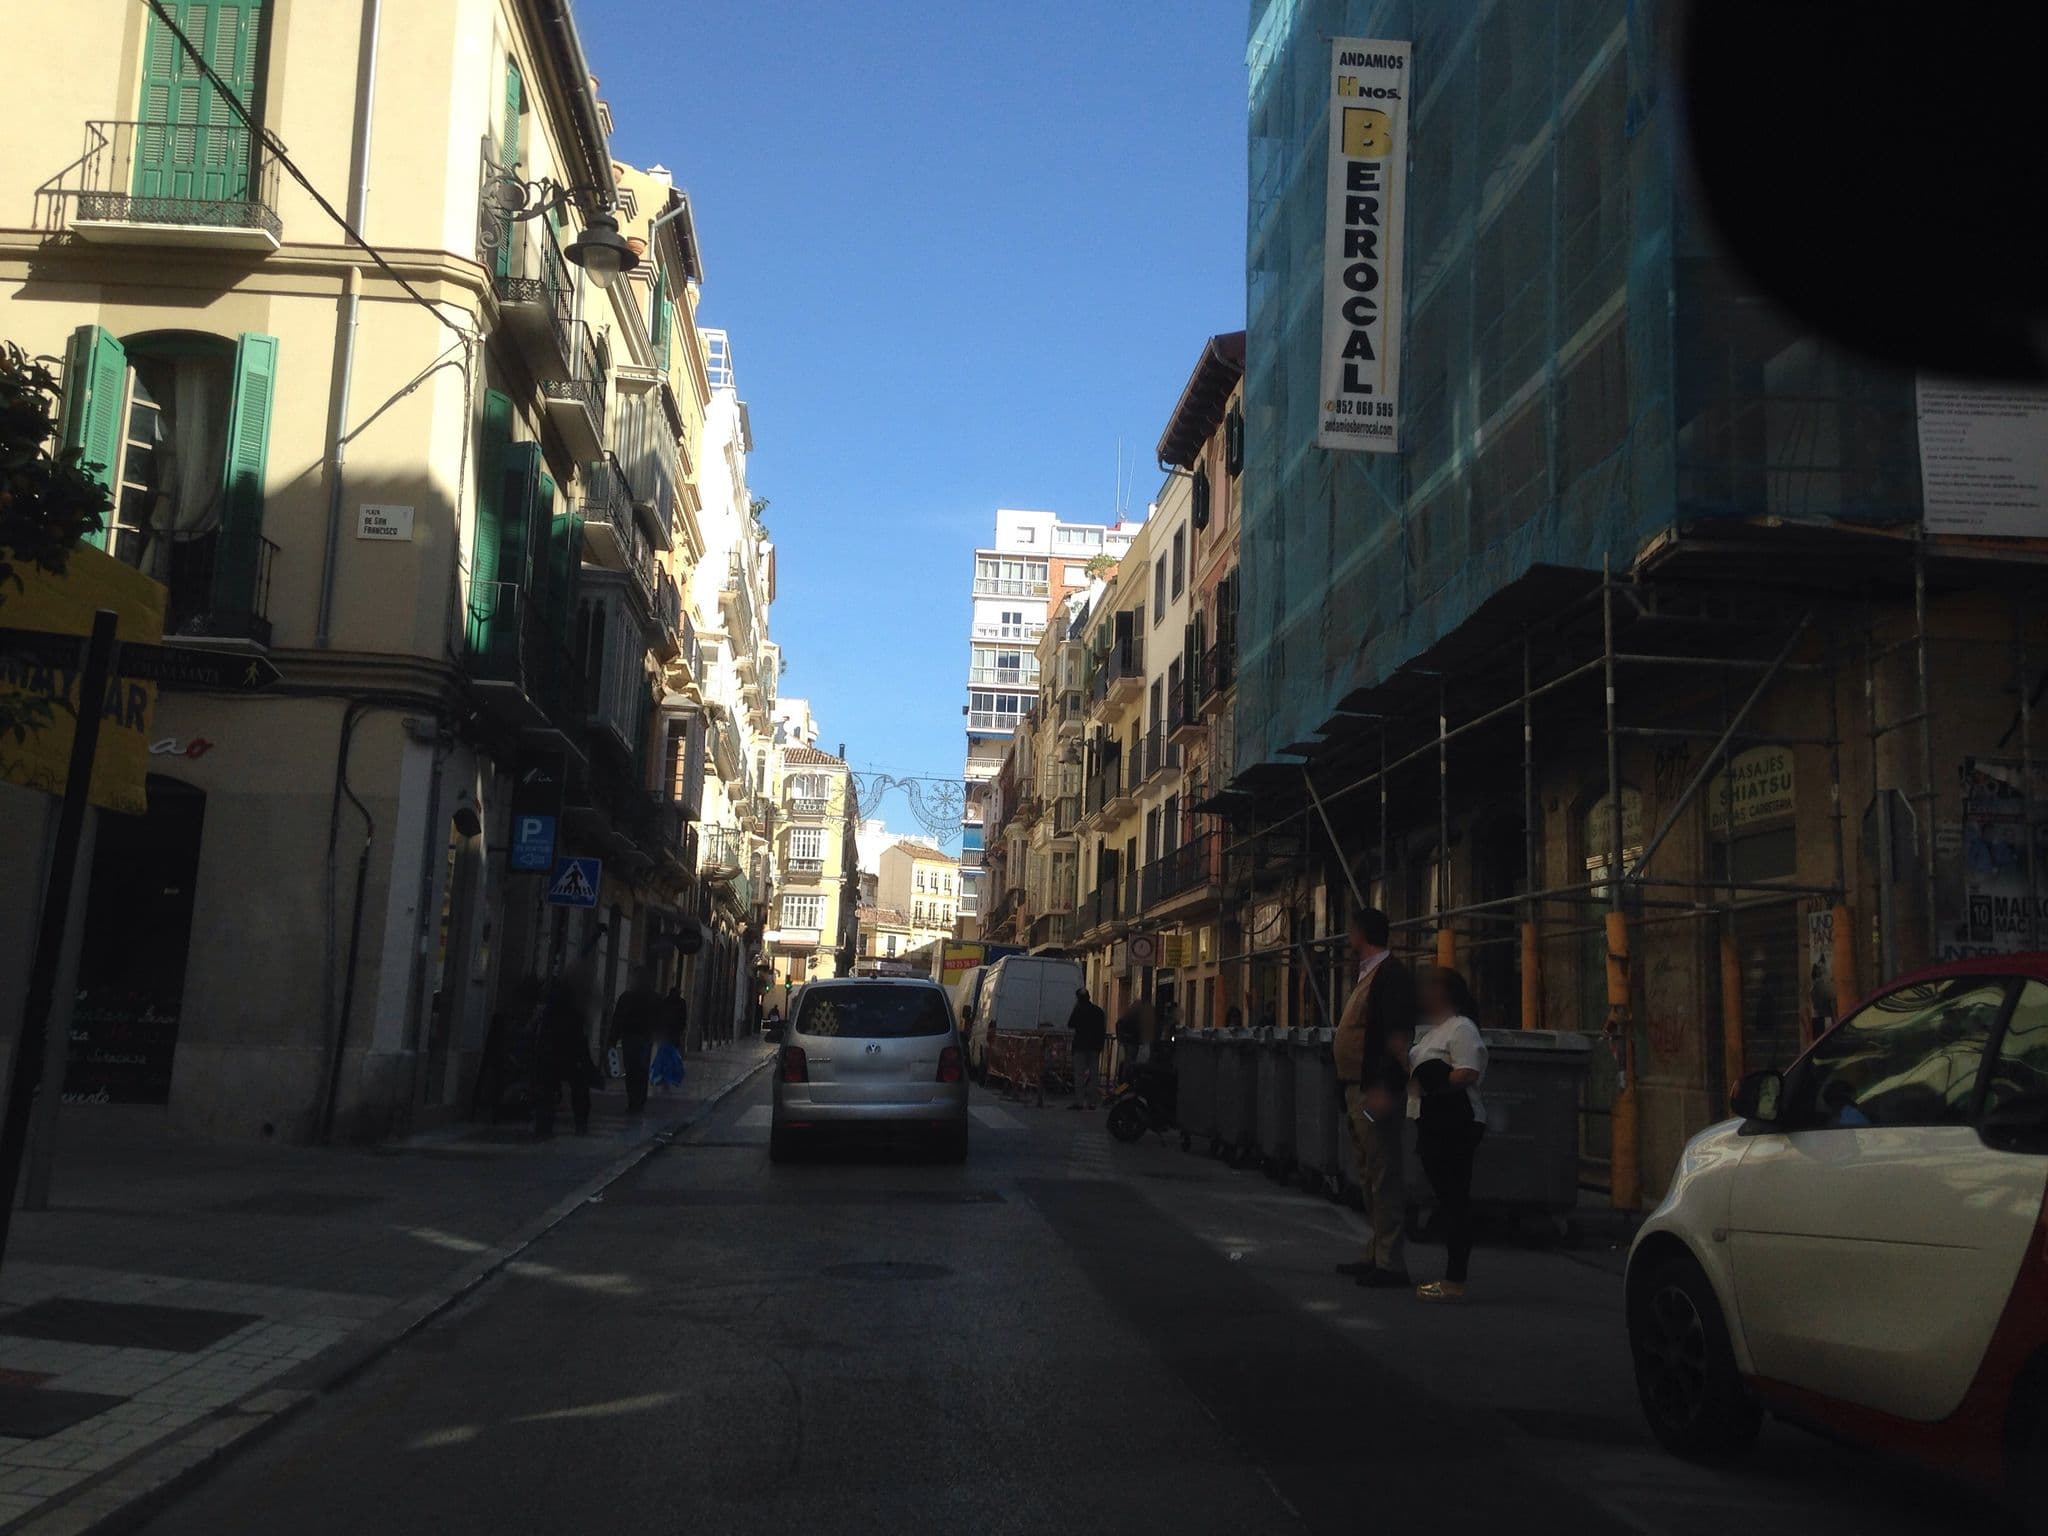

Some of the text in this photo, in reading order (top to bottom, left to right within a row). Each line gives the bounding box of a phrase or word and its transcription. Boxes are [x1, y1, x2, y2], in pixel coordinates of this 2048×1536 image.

[1339, 52, 1403, 69] ANDAMIOS
[1341, 106, 1394, 394] BERROCAL
[1336, 399, 1353, 414] 952
[1325, 418, 1393, 436] andamiosberrocal.com
[363, 526, 398, 536] FRANCISCO
[1719, 773, 1791, 806] SHIATSU
[521, 818, 543, 844] P
